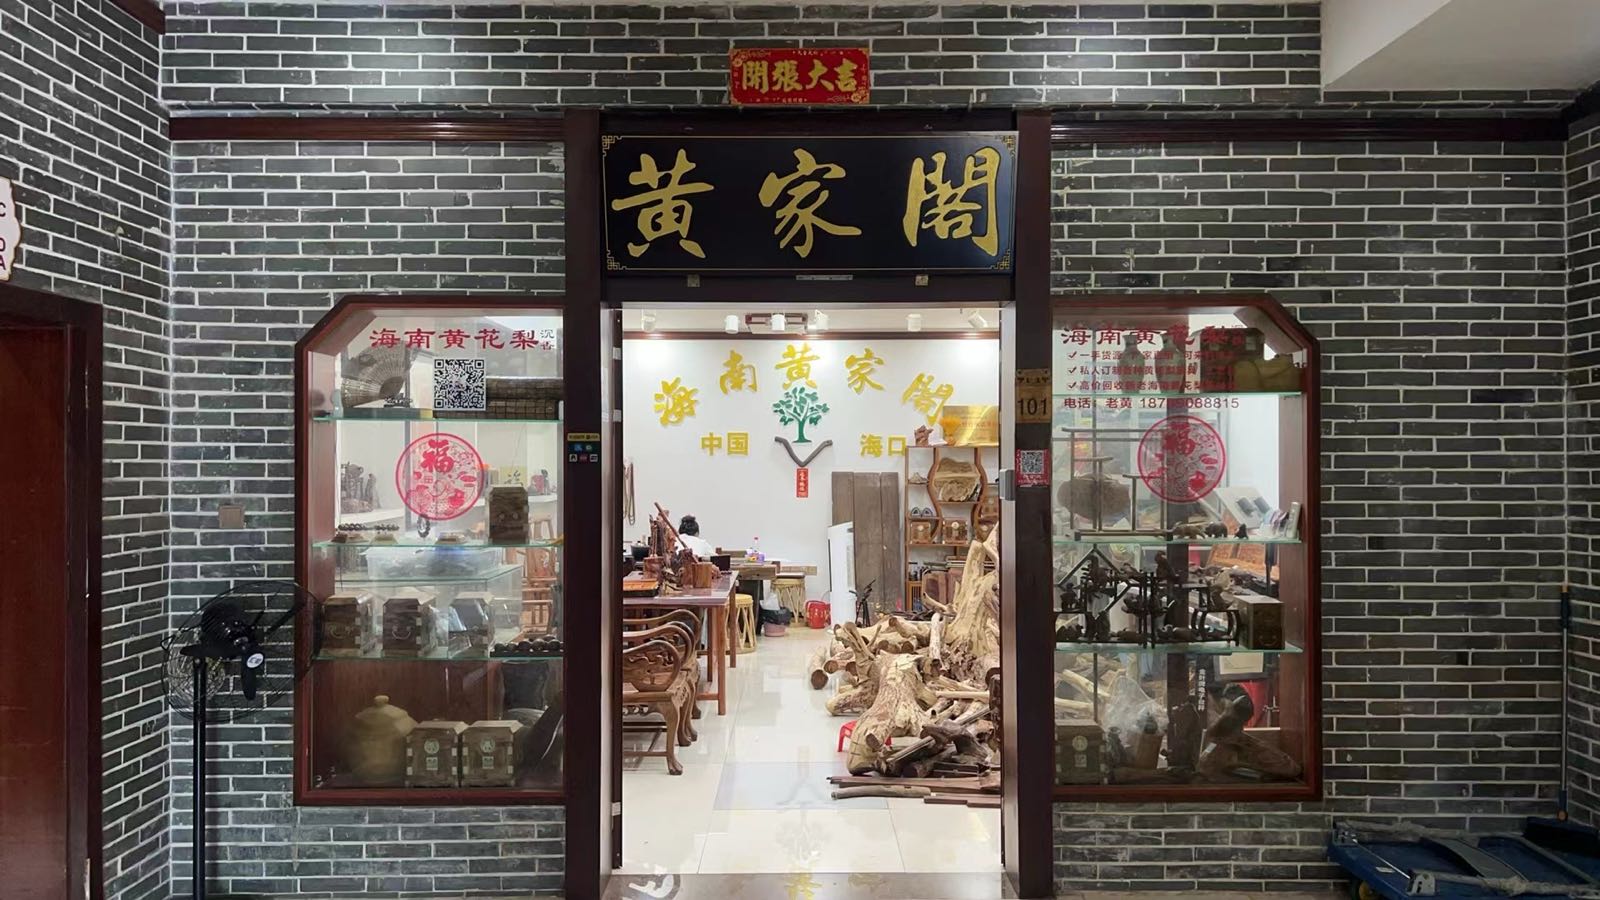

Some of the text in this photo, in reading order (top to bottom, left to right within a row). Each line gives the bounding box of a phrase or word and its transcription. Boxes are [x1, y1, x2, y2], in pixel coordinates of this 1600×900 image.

[369, 328, 539, 349] 海南黄花梨
[1017, 397, 1047, 416] 101
[1105, 397, 1132, 409] 老黄
[701, 432, 907, 457] 中国 海口
